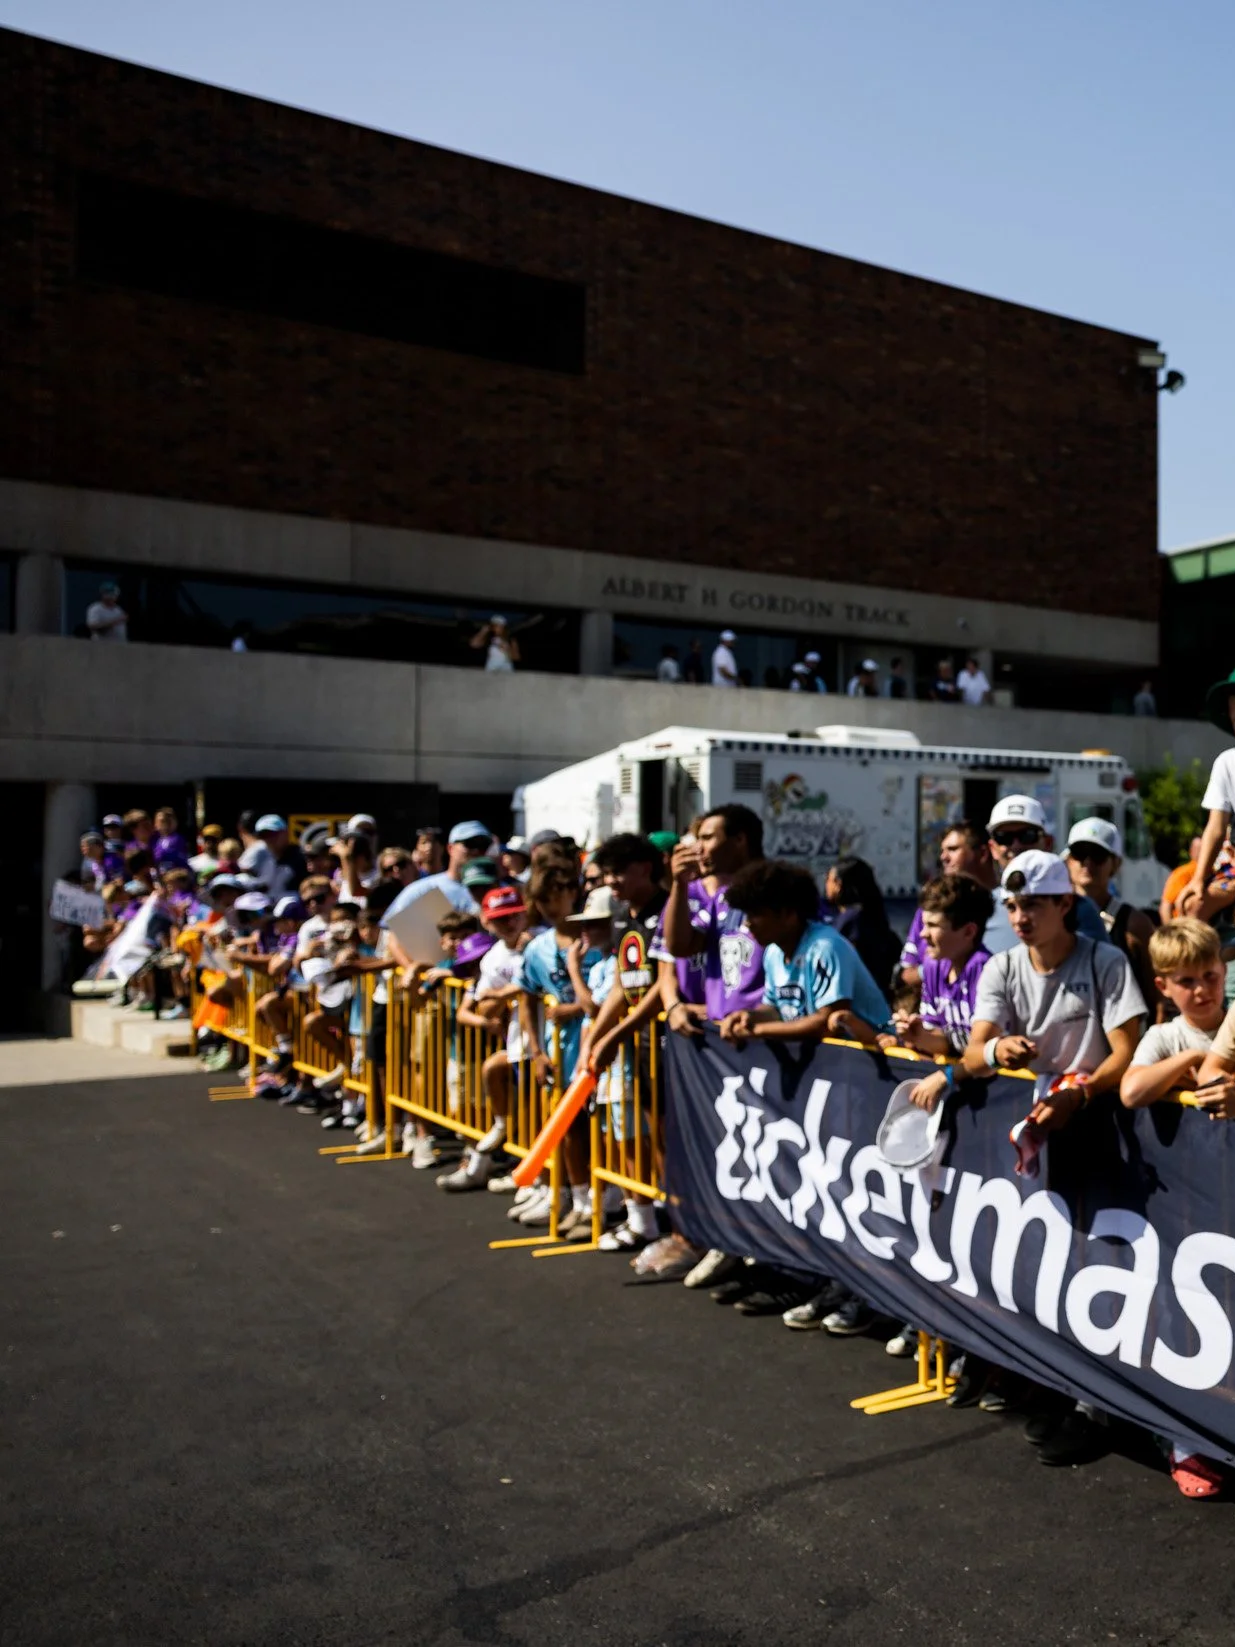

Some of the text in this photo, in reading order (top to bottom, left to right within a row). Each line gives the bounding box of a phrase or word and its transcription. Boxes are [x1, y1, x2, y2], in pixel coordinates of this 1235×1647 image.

[602, 576, 910, 627] ALBERT H GORDON TRACK
